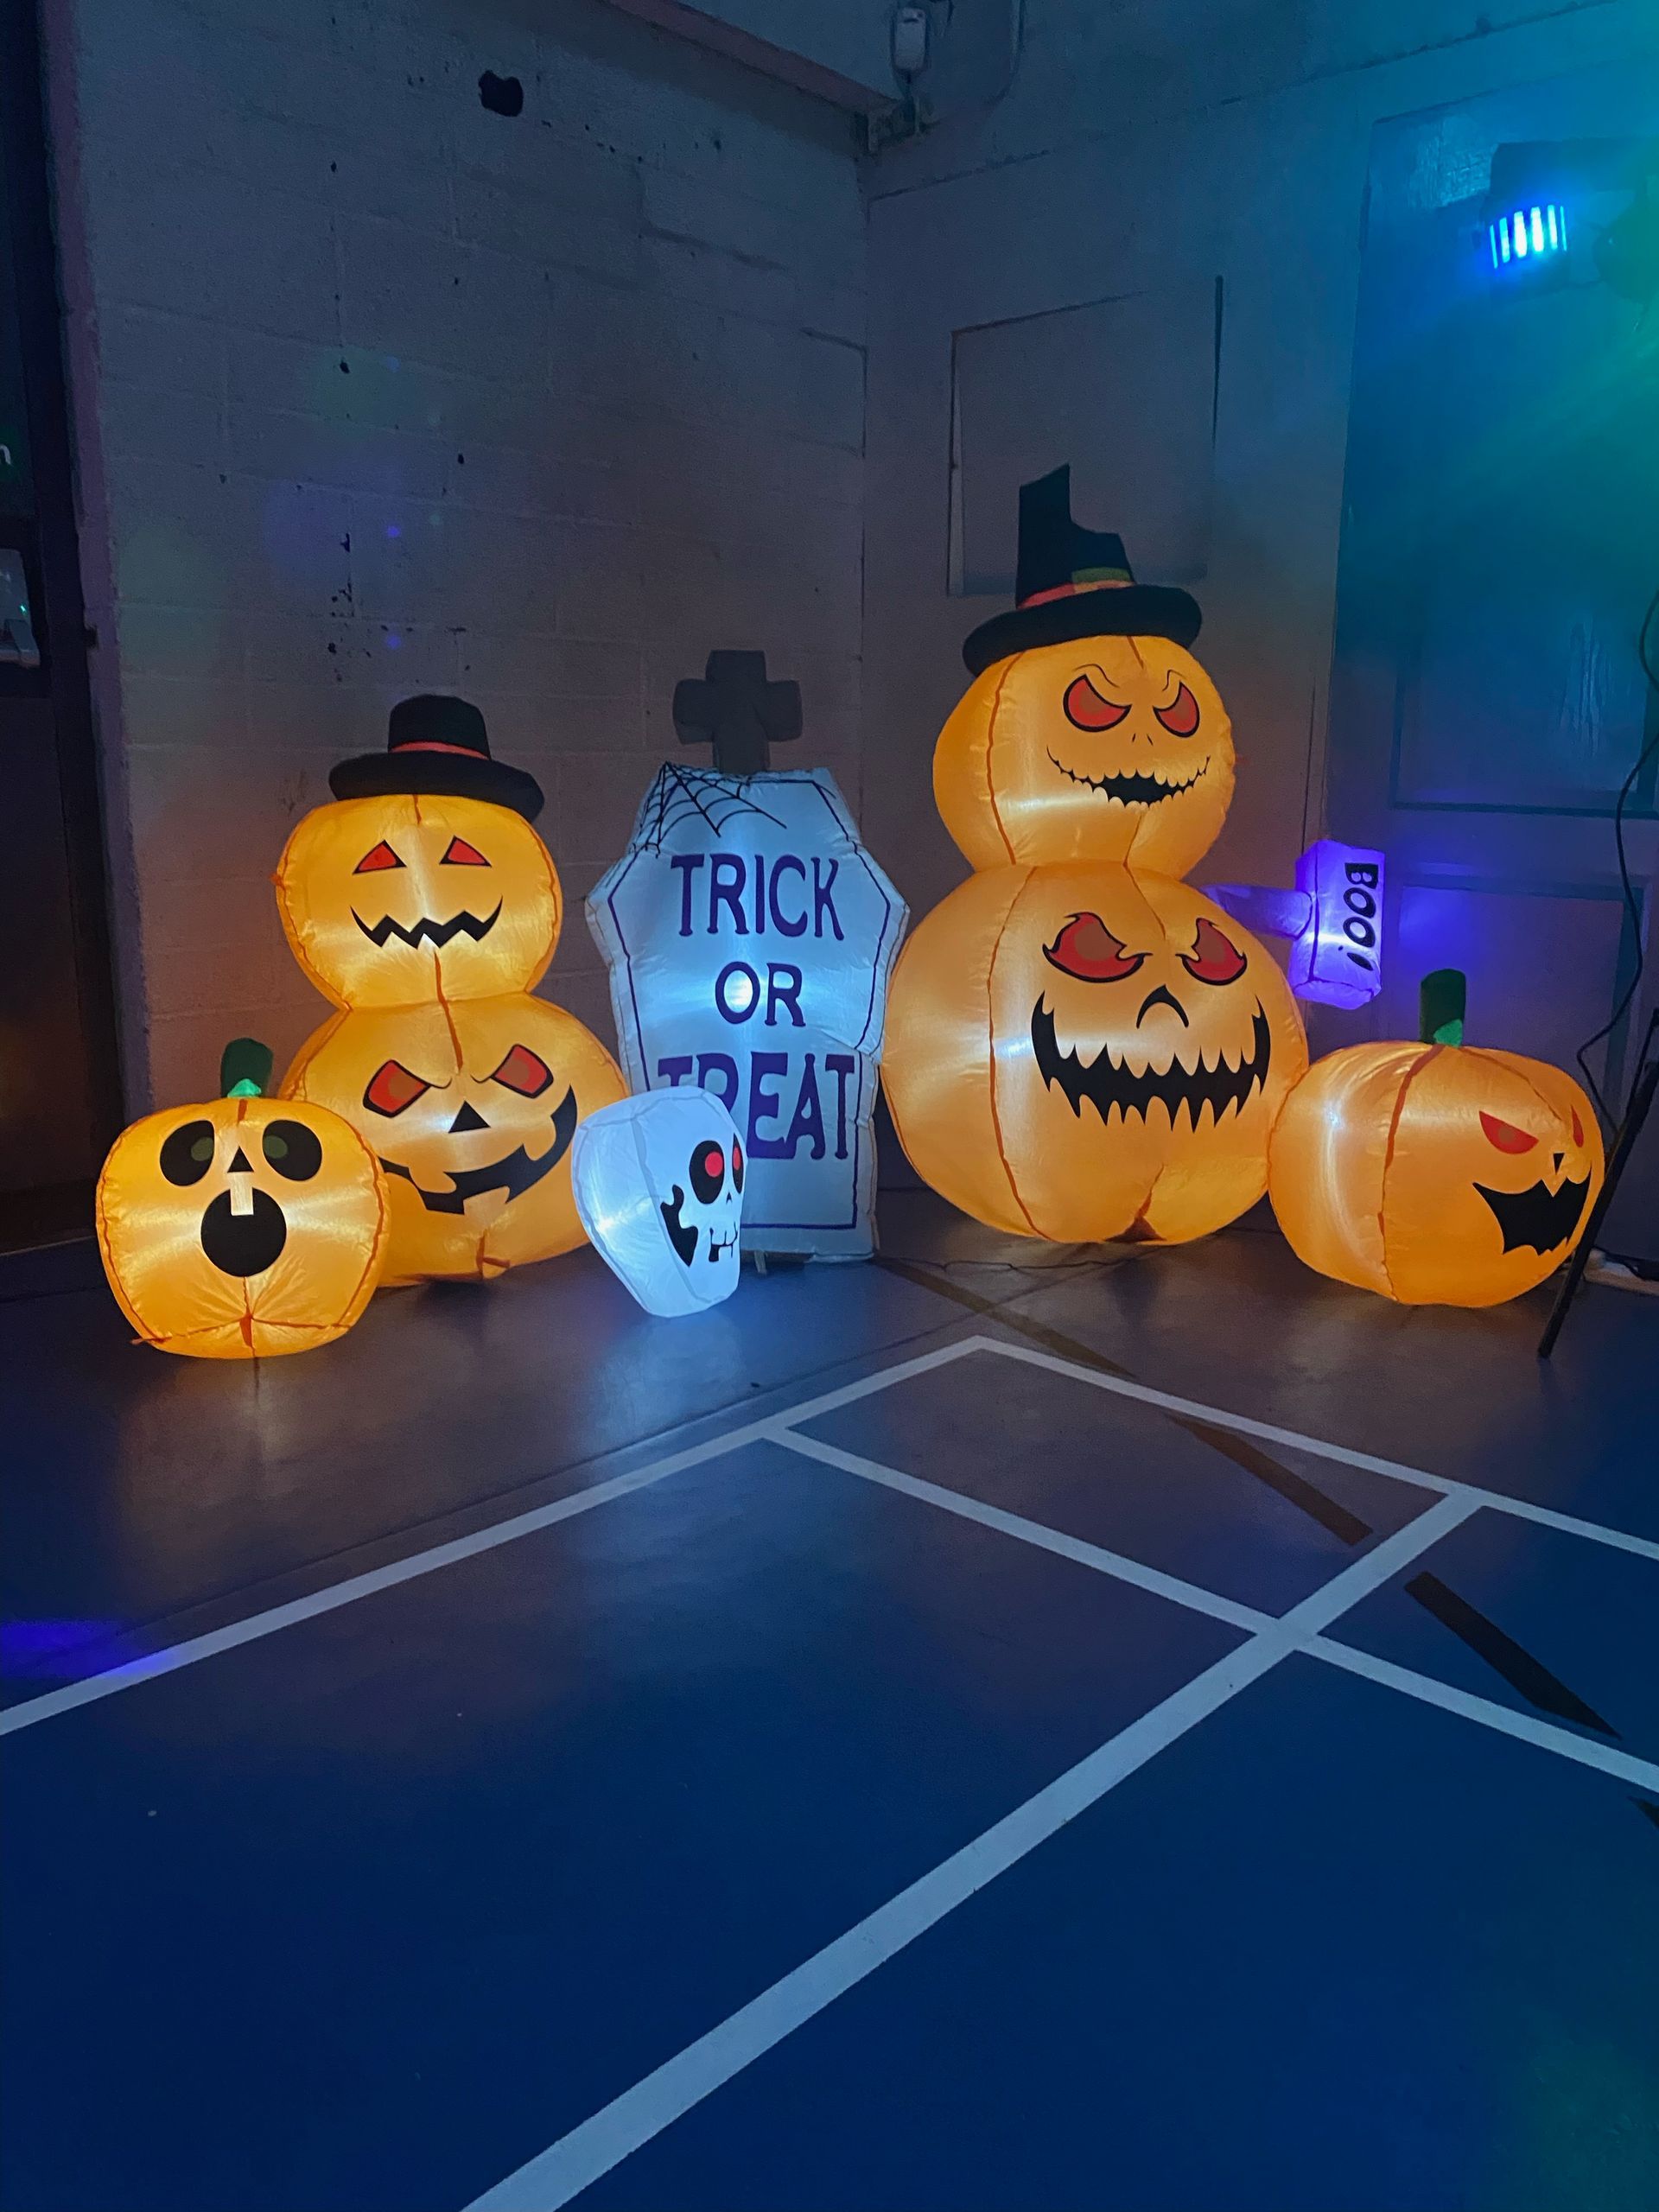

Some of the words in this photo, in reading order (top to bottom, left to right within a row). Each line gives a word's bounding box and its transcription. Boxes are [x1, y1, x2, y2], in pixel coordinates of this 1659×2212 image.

[671, 853, 844, 941] TRICK
[1338, 862, 1379, 971] BOO!
[715, 961, 806, 1027] OR
